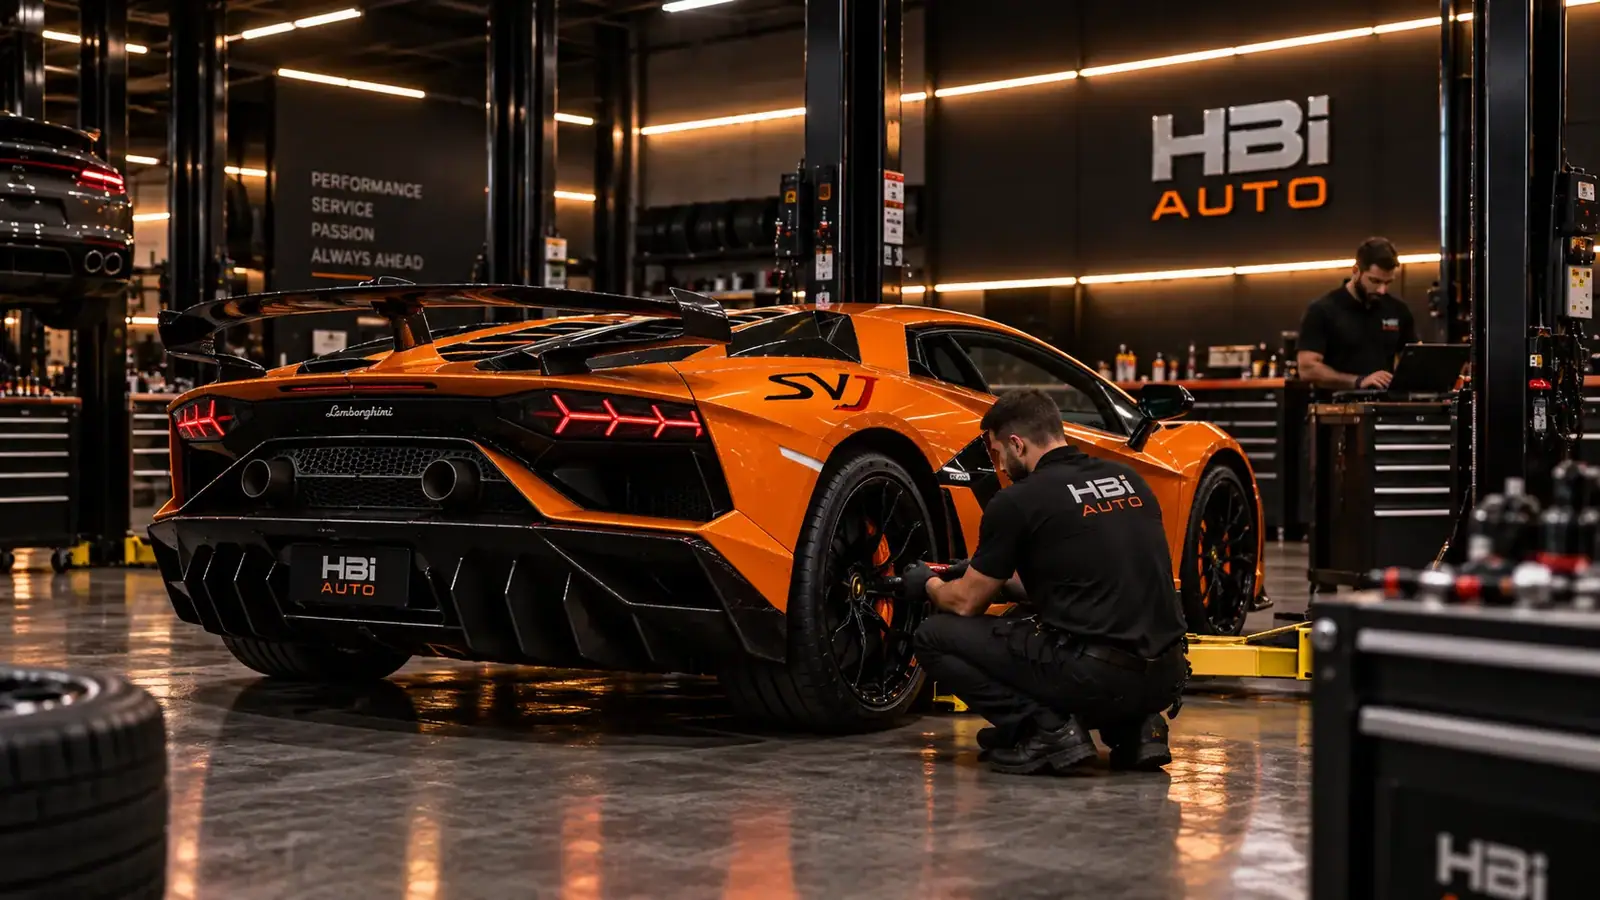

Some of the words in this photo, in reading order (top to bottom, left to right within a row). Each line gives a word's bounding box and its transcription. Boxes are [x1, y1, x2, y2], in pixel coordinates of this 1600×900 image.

[1152, 95, 1329, 181] HBi
[311, 171, 423, 199] PERFORMANCE
[312, 196, 374, 218] SERVICE
[1151, 175, 1328, 221] AUTO
[311, 222, 375, 242] PASSION
[311, 247, 371, 267] ALWAYS
[374, 252, 424, 271] AHEAD
[764, 372, 879, 412] SVJ
[325, 404, 394, 420] Lamborghini
[1066, 474, 1136, 504] HBi
[1083, 496, 1144, 517] AUTO
[322, 555, 376, 581] HBi
[321, 582, 375, 596] AUTO
